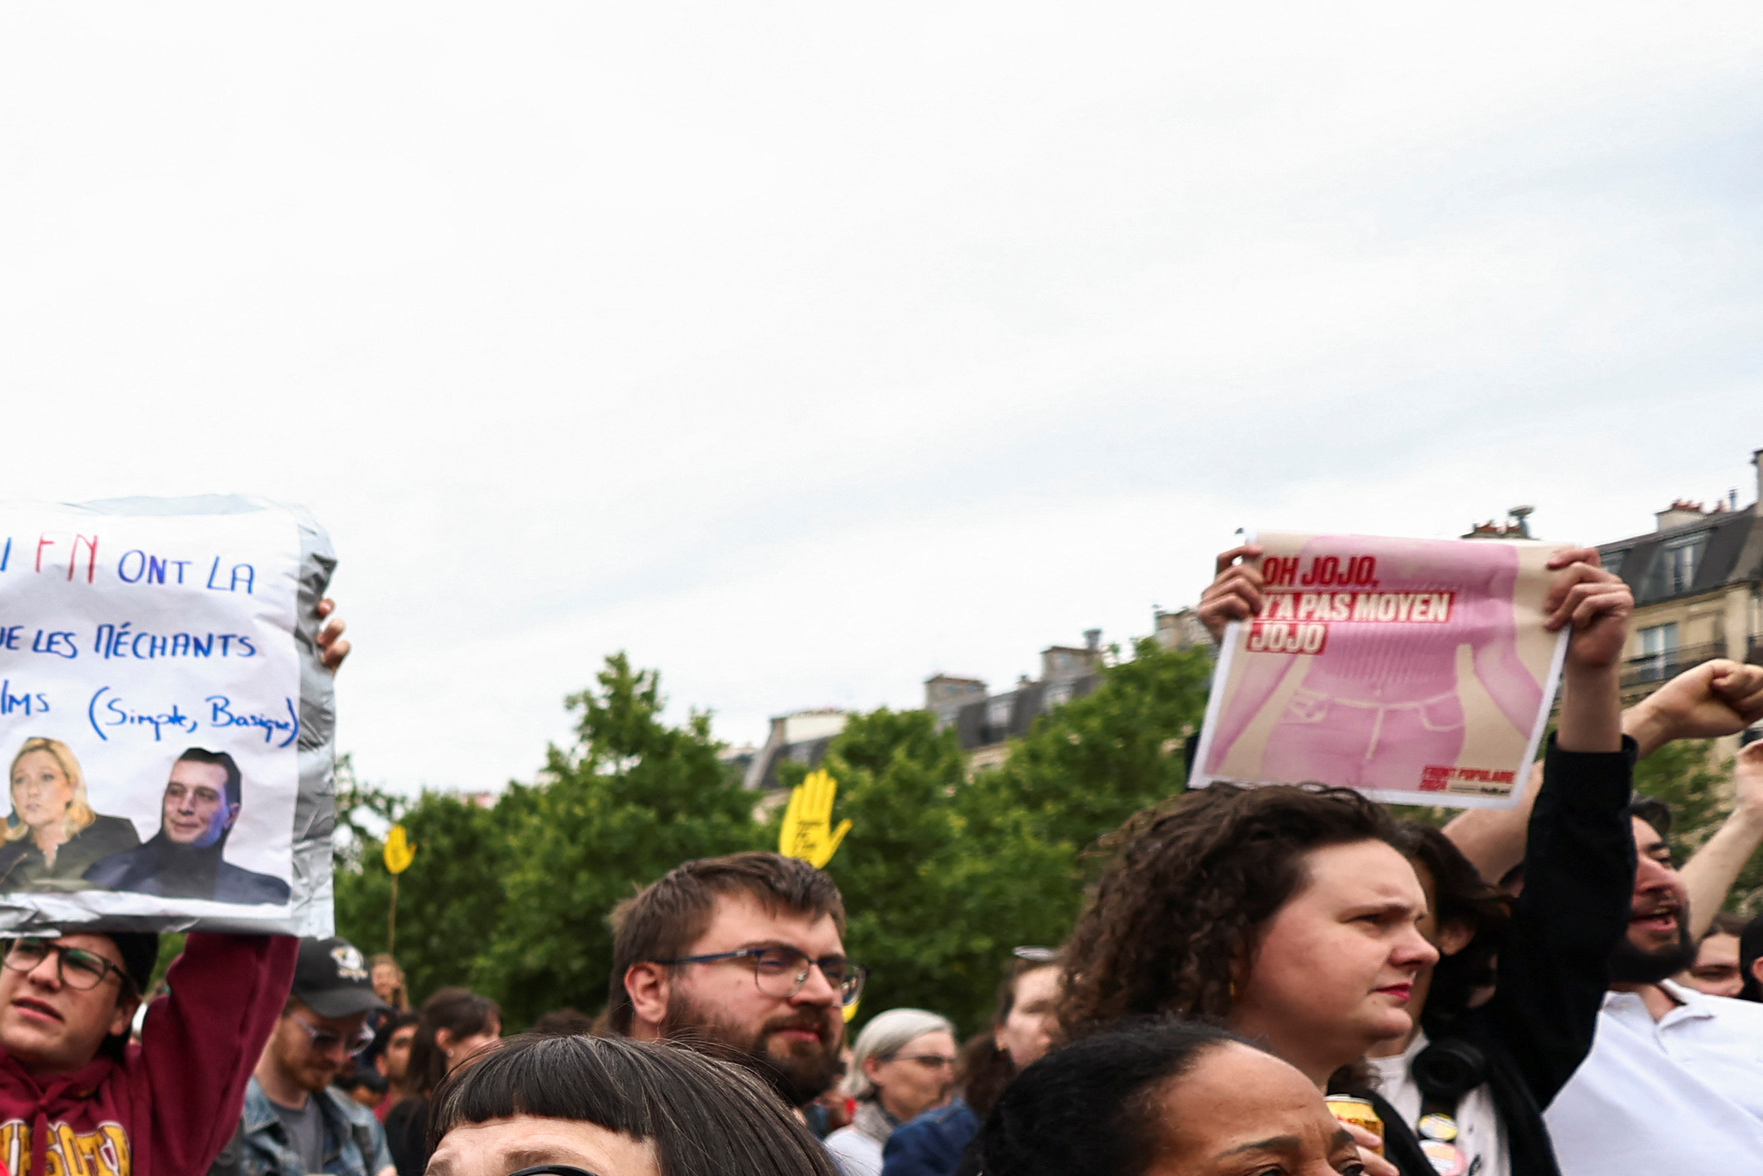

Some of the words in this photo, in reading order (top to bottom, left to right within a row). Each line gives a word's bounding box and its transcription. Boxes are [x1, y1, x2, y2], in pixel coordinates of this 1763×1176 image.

[34, 531, 100, 585] FN
[117, 549, 192, 585] ONT
[206, 555, 256, 595] LA
[1261, 556, 1300, 586] OH
[1301, 555, 1381, 588] JOJO,
[1296, 592, 1353, 622] PAS
[1352, 592, 1452, 623] MOYEN
[32, 628, 79, 660] LES
[93, 621, 258, 661] MÉCHANTS
[1250, 622, 1327, 654] JOJO
